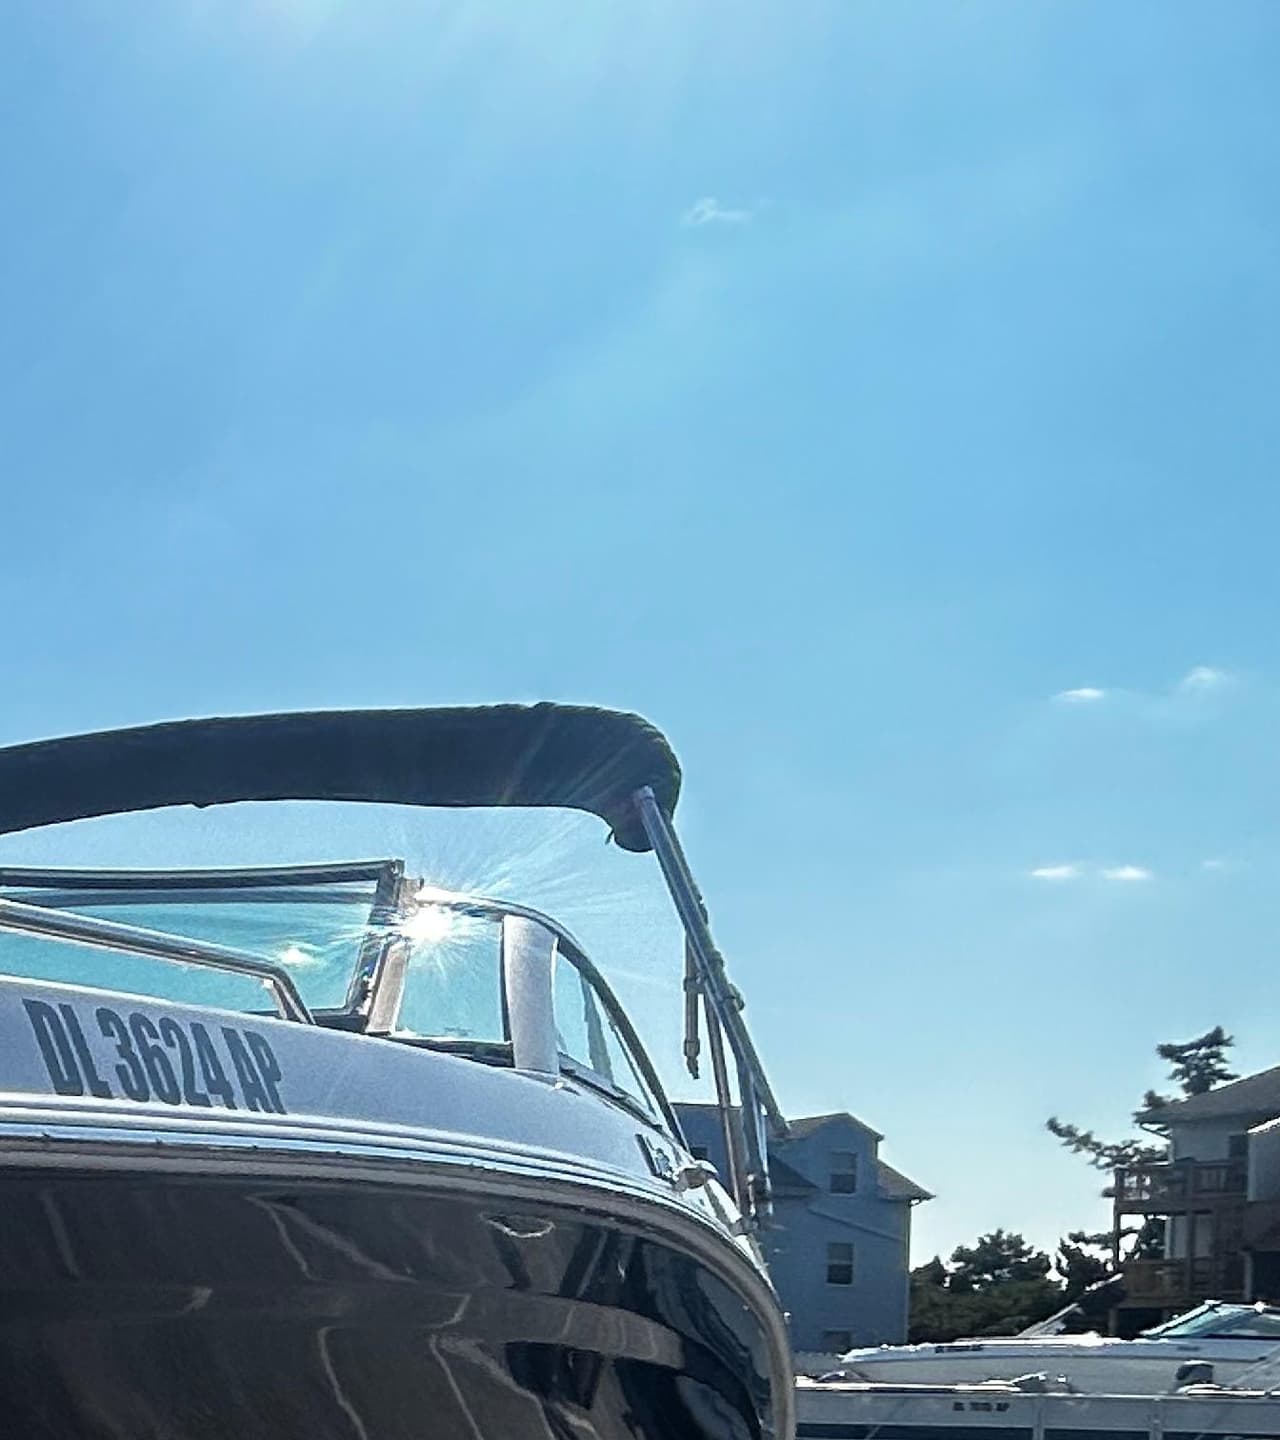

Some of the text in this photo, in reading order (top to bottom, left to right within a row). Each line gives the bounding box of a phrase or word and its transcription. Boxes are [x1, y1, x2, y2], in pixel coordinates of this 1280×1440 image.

[23, 999, 287, 1114] DL 3624 AP
